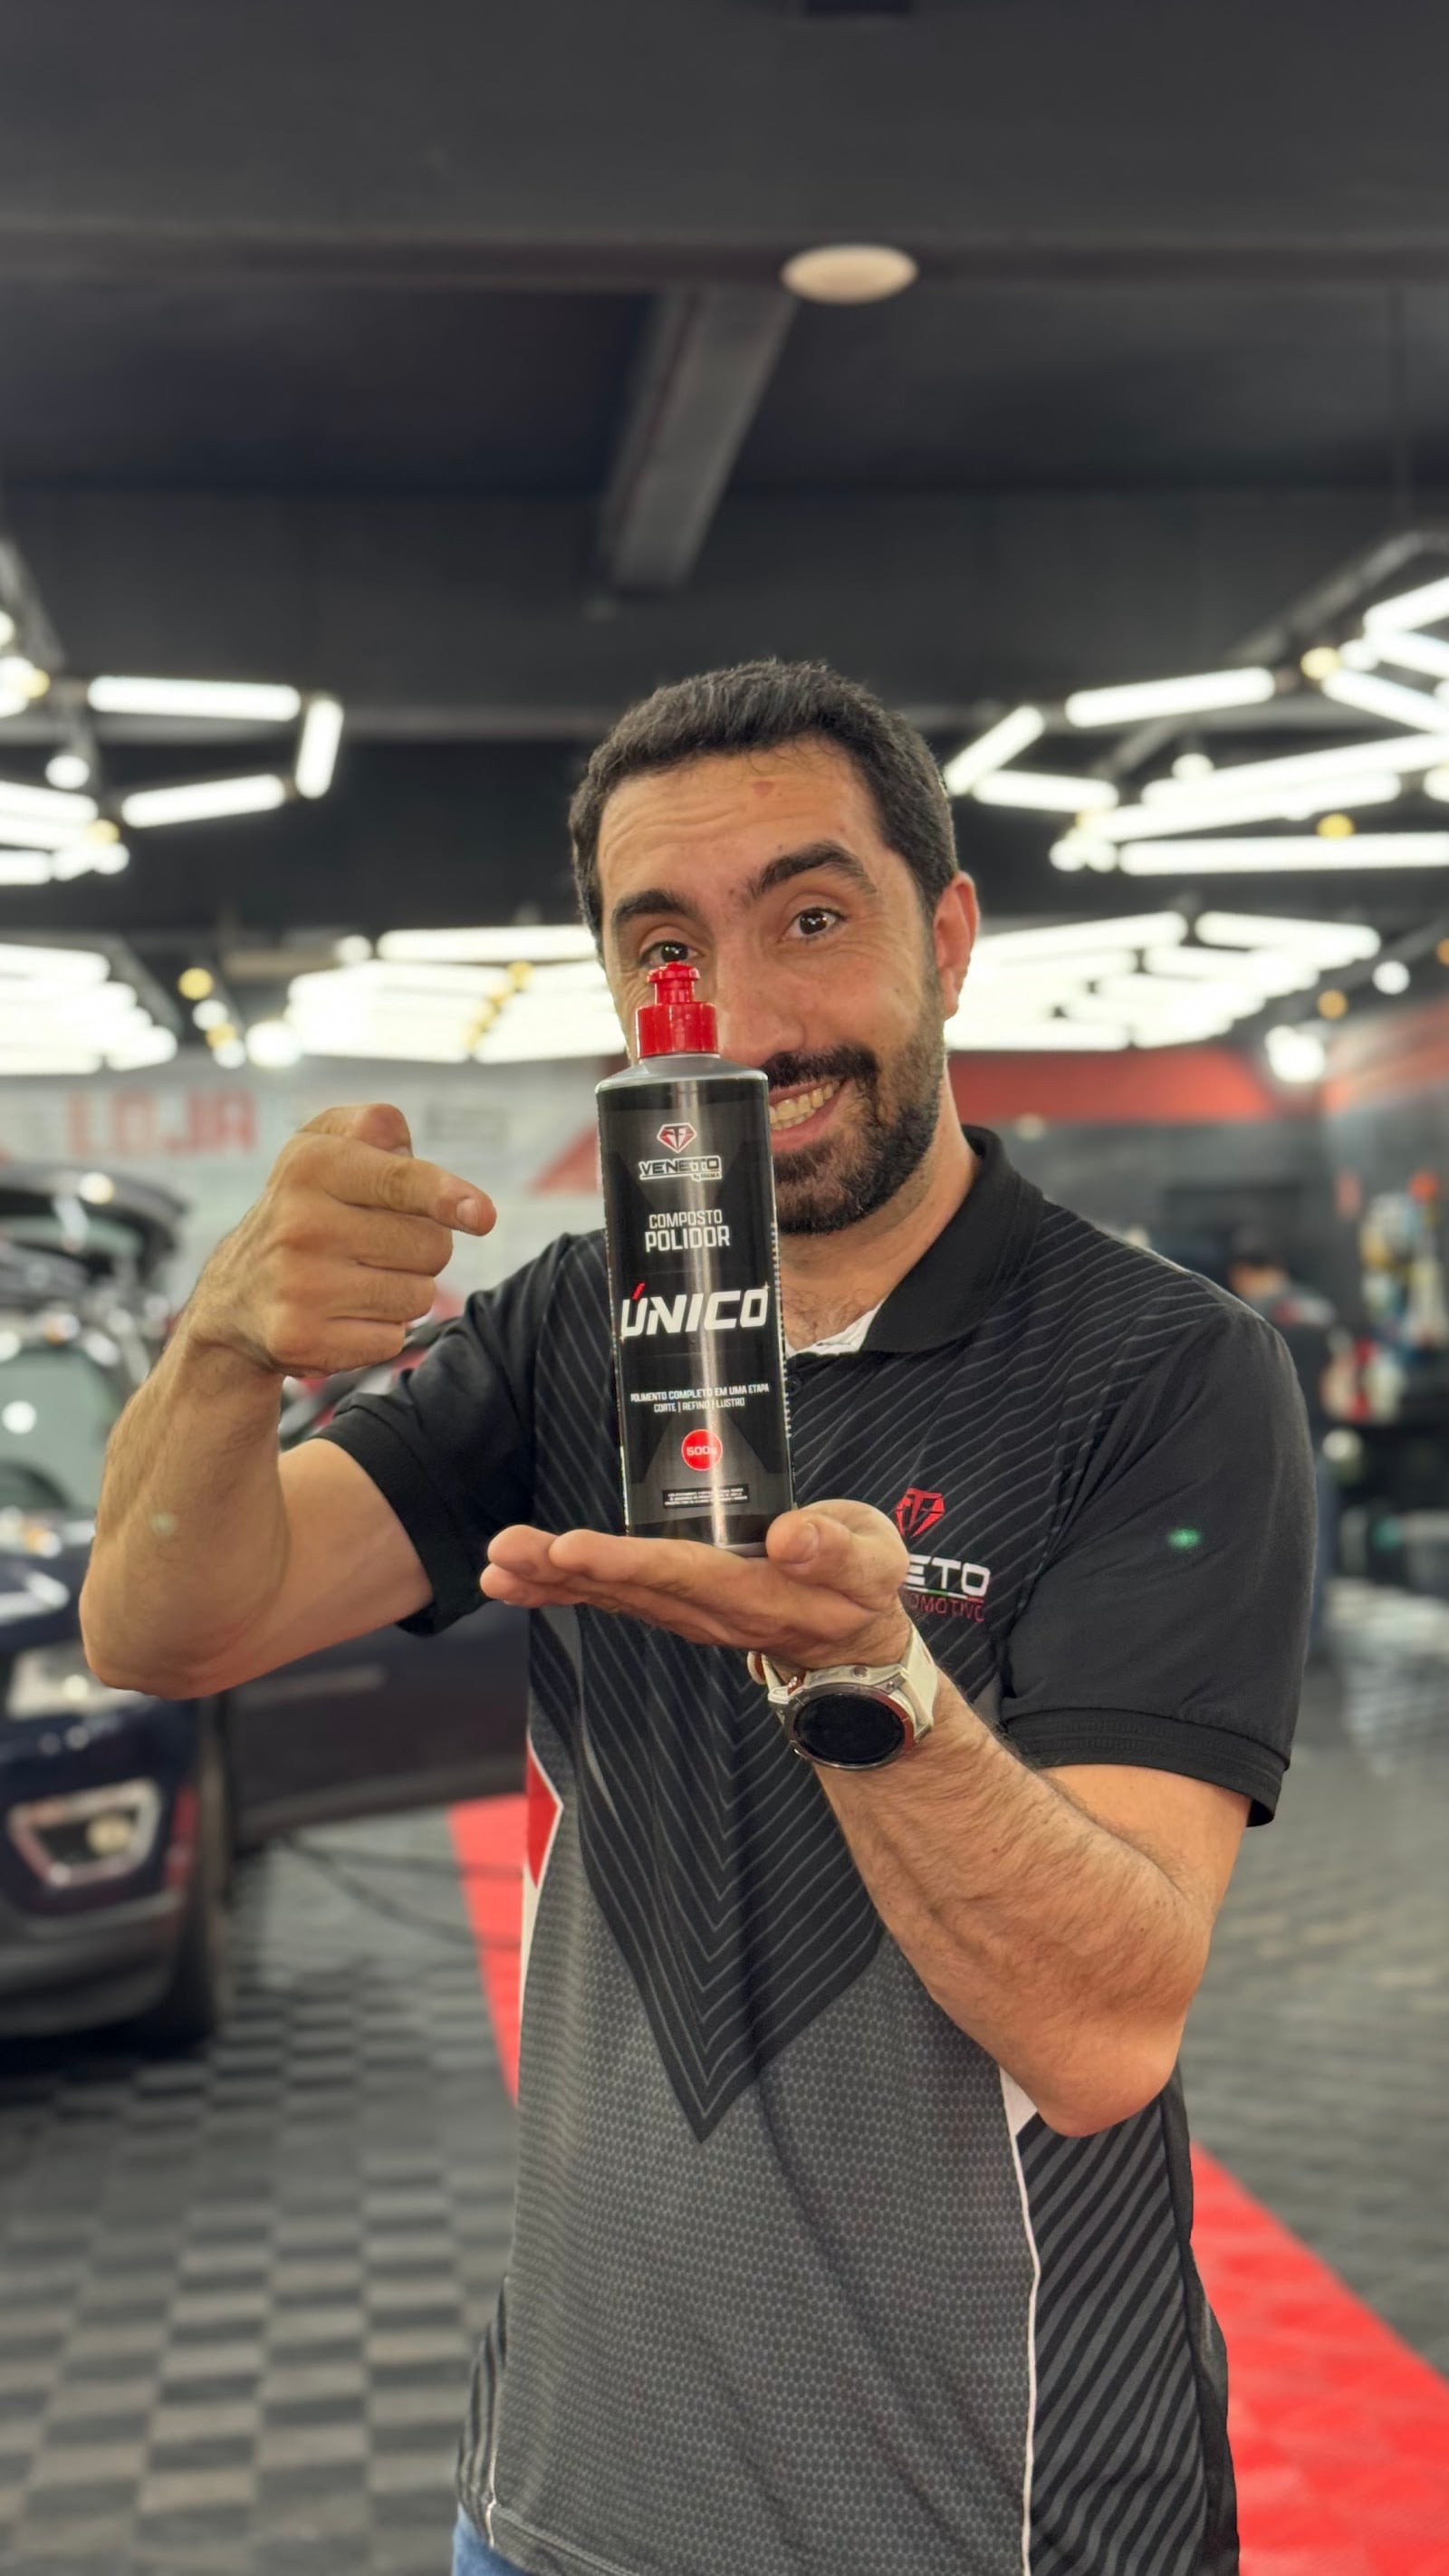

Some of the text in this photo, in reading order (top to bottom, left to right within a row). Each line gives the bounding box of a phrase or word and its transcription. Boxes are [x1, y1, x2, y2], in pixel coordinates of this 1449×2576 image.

[65, 1089, 257, 1159] LOJA
[639, 1157, 720, 1176] VENETO
[648, 1209, 723, 1229] COMPOSTO
[645, 1226, 730, 1253] POLIDOR
[619, 1281, 769, 1338] ÚNICO
[668, 1389, 712, 1400] COMPLETO
[715, 1386, 727, 1397] EM
[729, 1384, 747, 1395] UMA
[748, 1382, 769, 1393] ETAPA
[716, 1397, 745, 1408] LUSTRO
